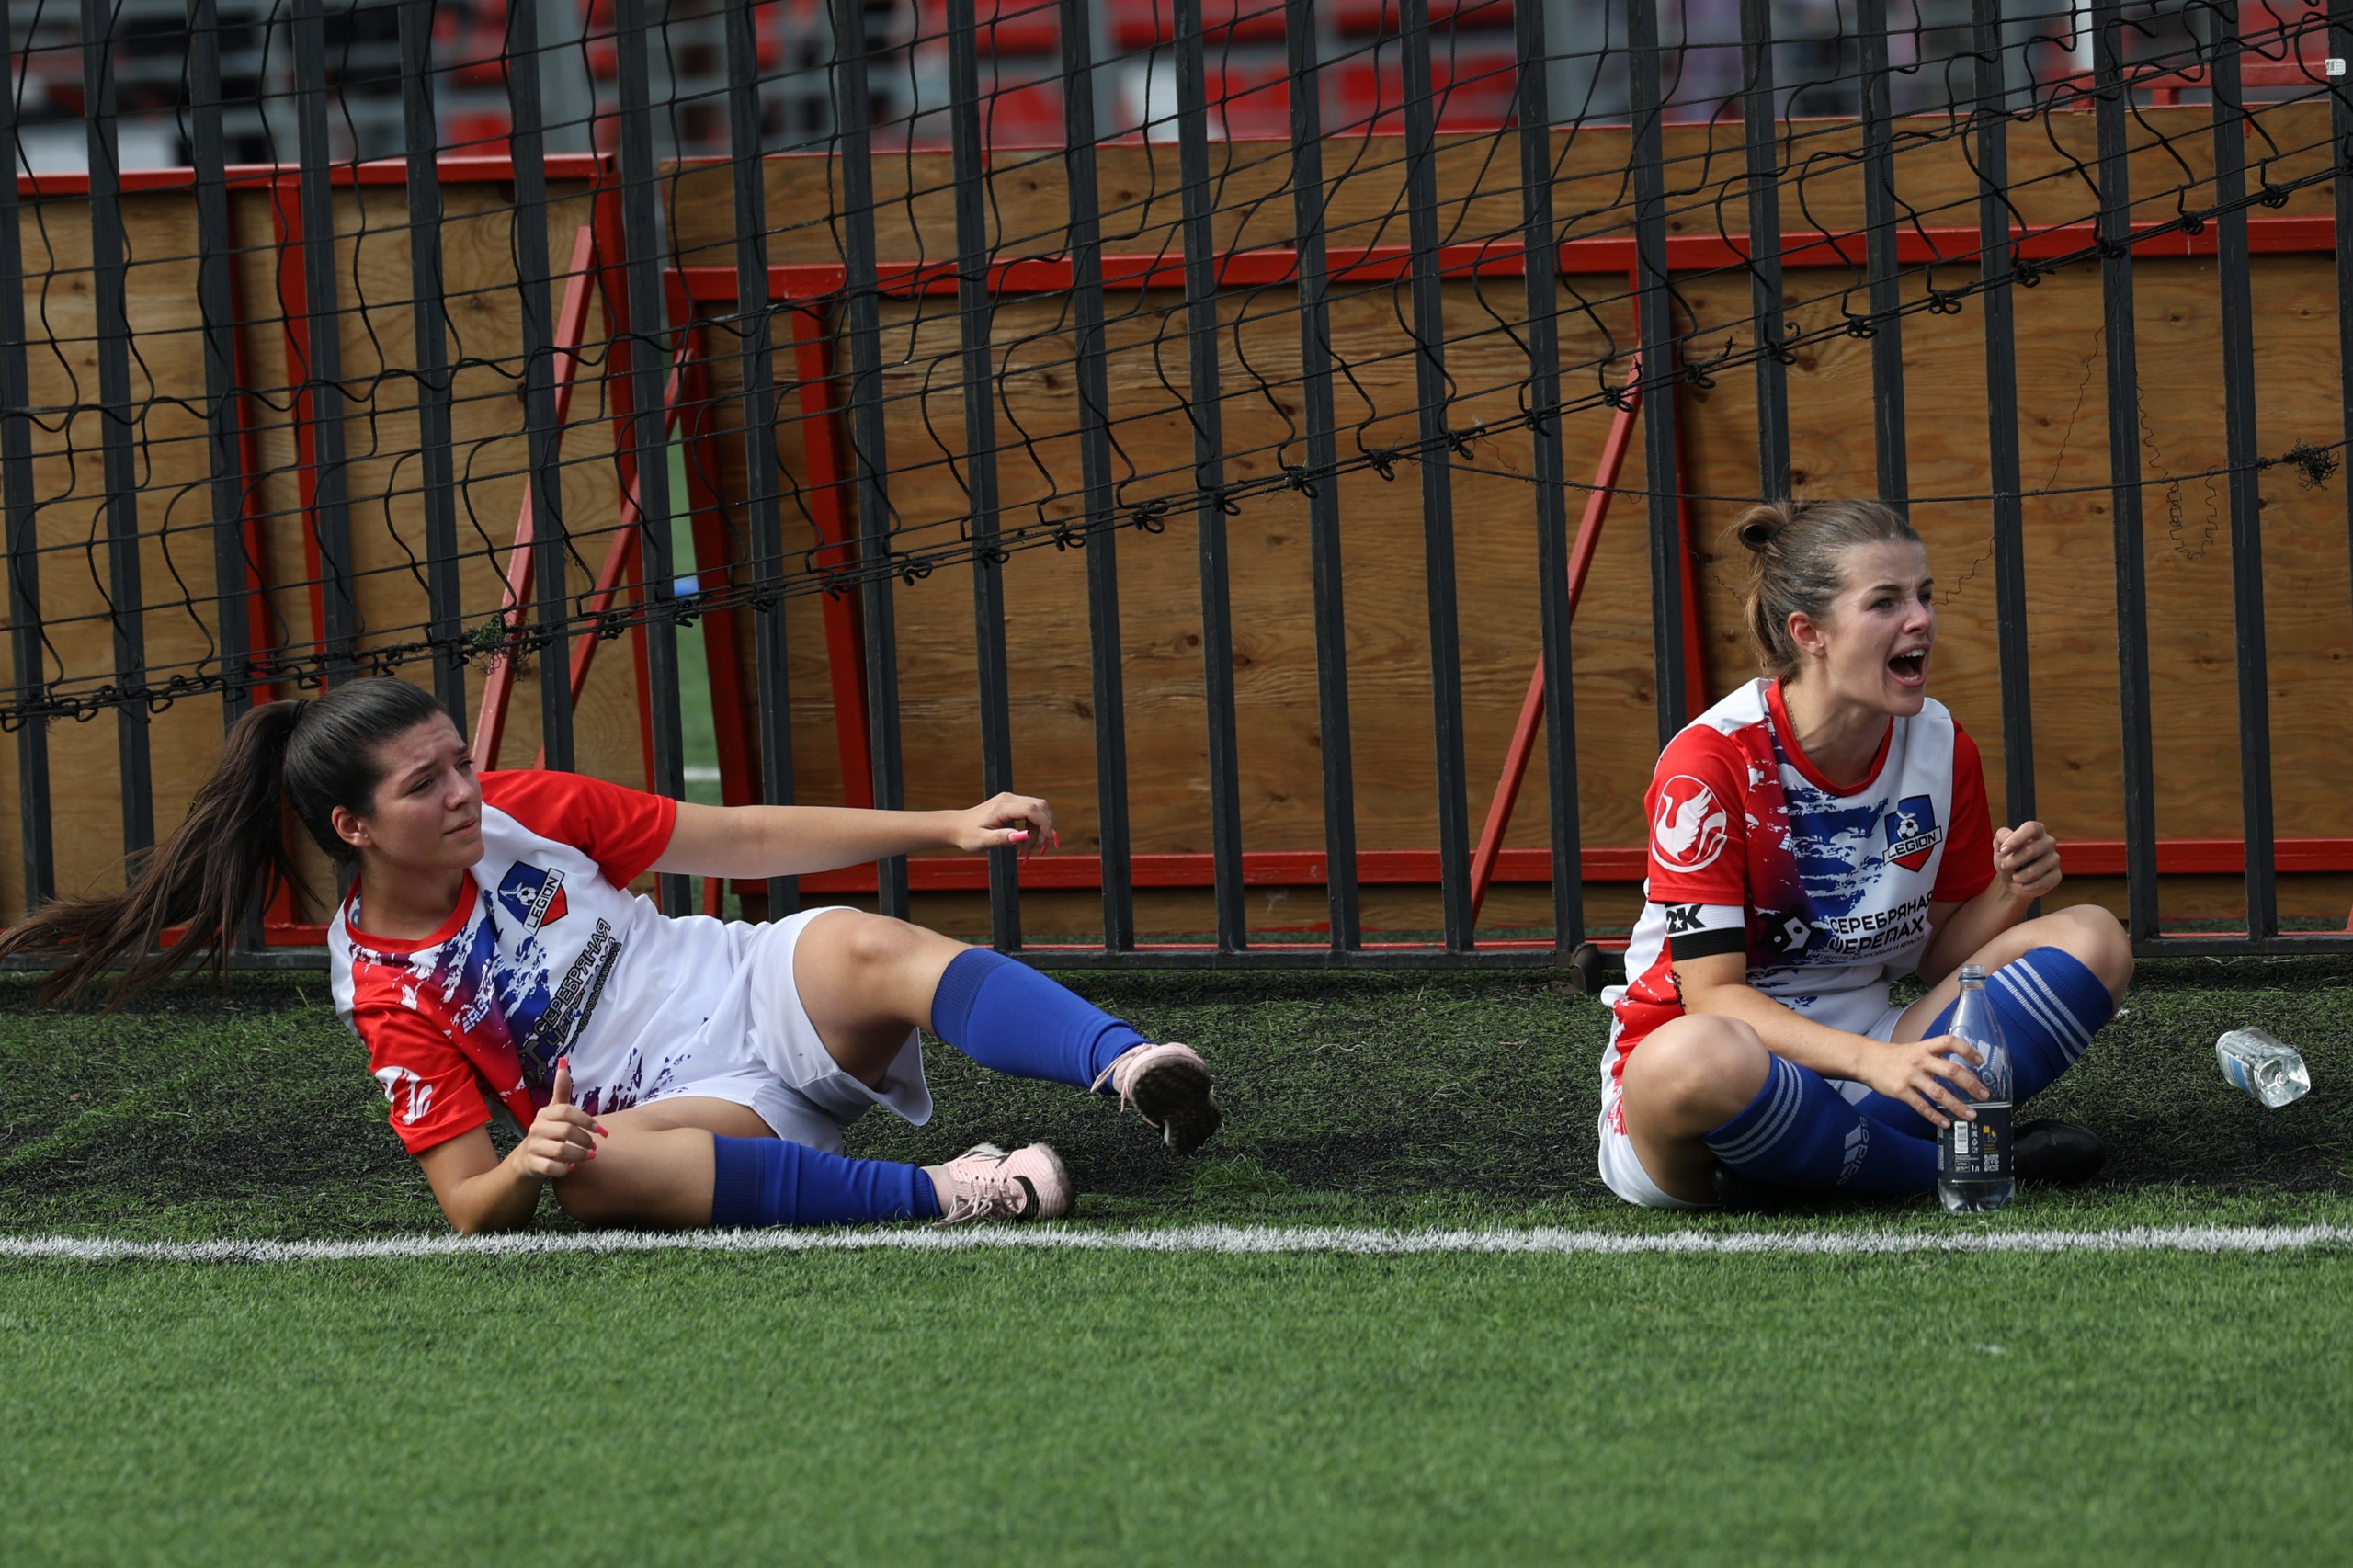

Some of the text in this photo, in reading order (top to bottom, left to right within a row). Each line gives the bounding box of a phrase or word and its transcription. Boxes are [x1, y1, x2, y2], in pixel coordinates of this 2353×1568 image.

[1888, 832, 1937, 858] LEGION
[526, 876, 559, 928] LEGION
[534, 918, 611, 1036] СЕРЕБРЯНАЯ
[1837, 1116, 1870, 1185] adidas
